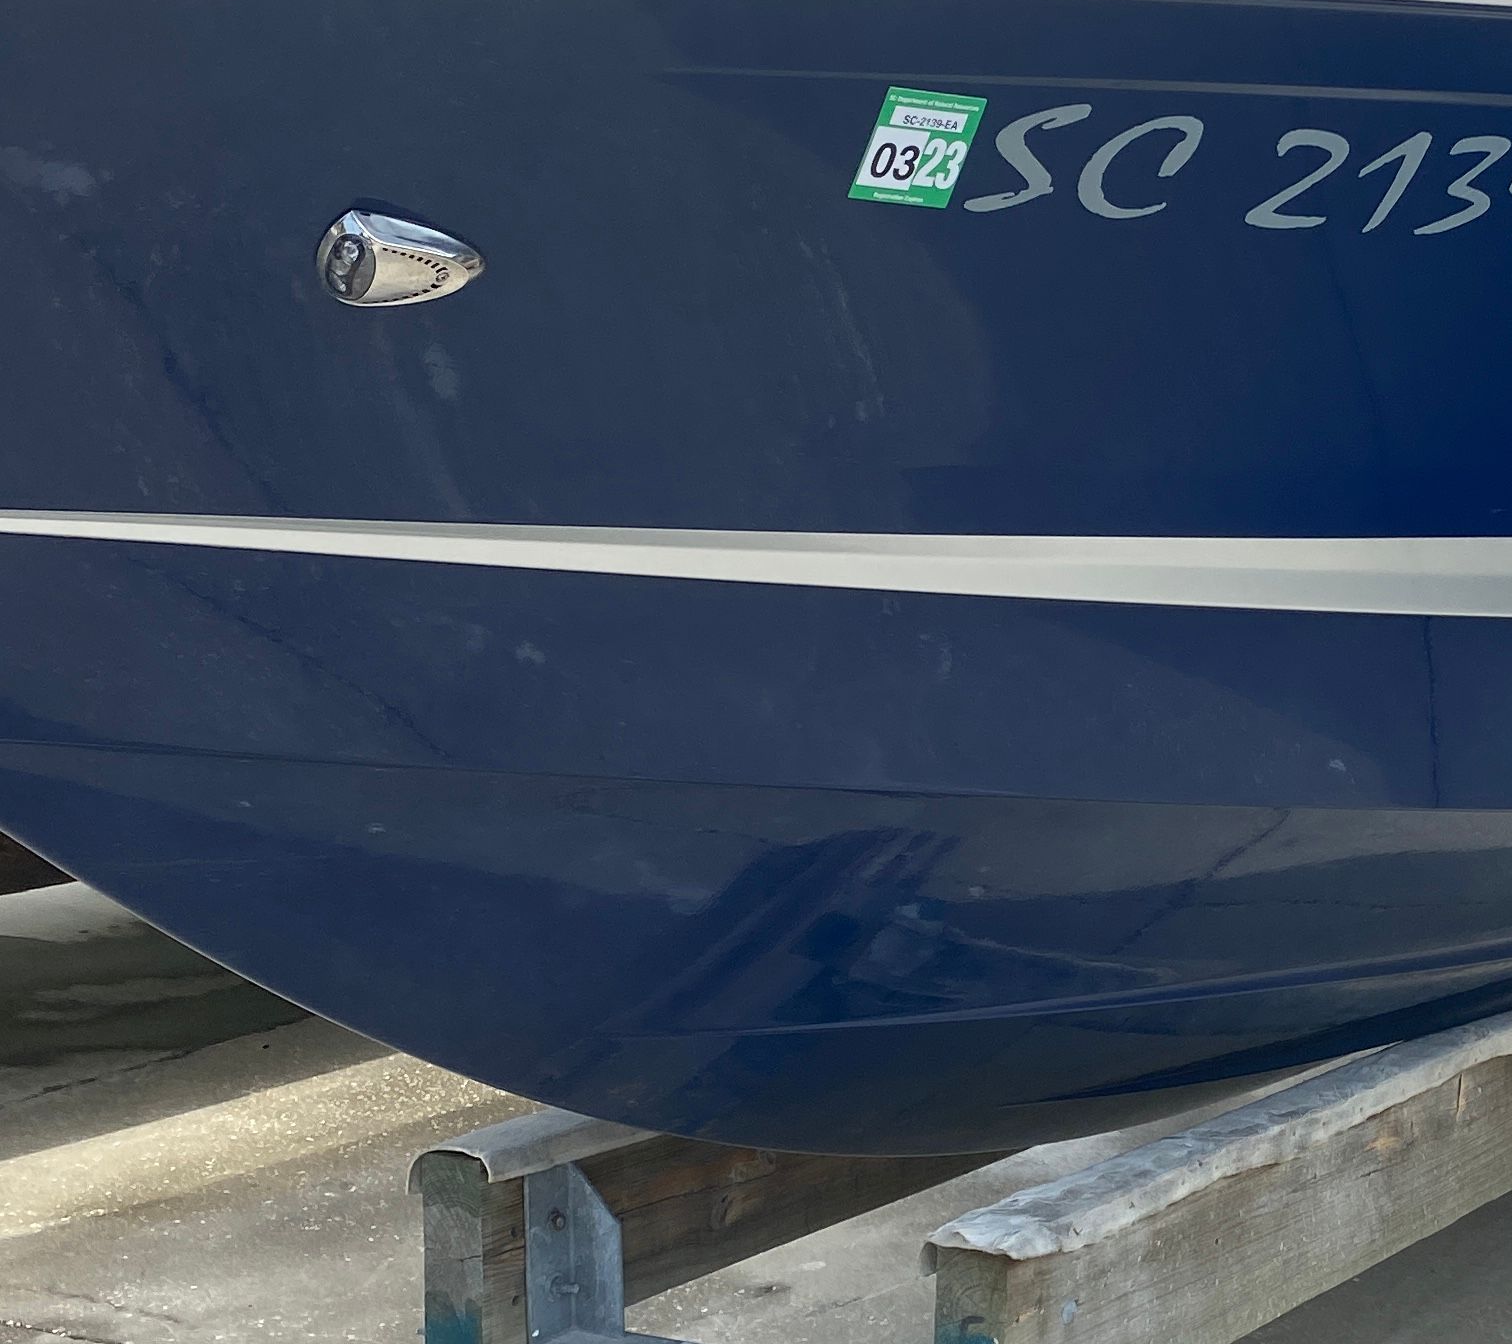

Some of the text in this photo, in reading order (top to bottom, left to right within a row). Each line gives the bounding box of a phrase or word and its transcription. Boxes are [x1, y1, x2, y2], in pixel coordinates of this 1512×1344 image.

[902, 114, 958, 131] SC-2139-EA
[870, 137, 968, 190] 03 23
[963, 103, 1204, 219] SC
